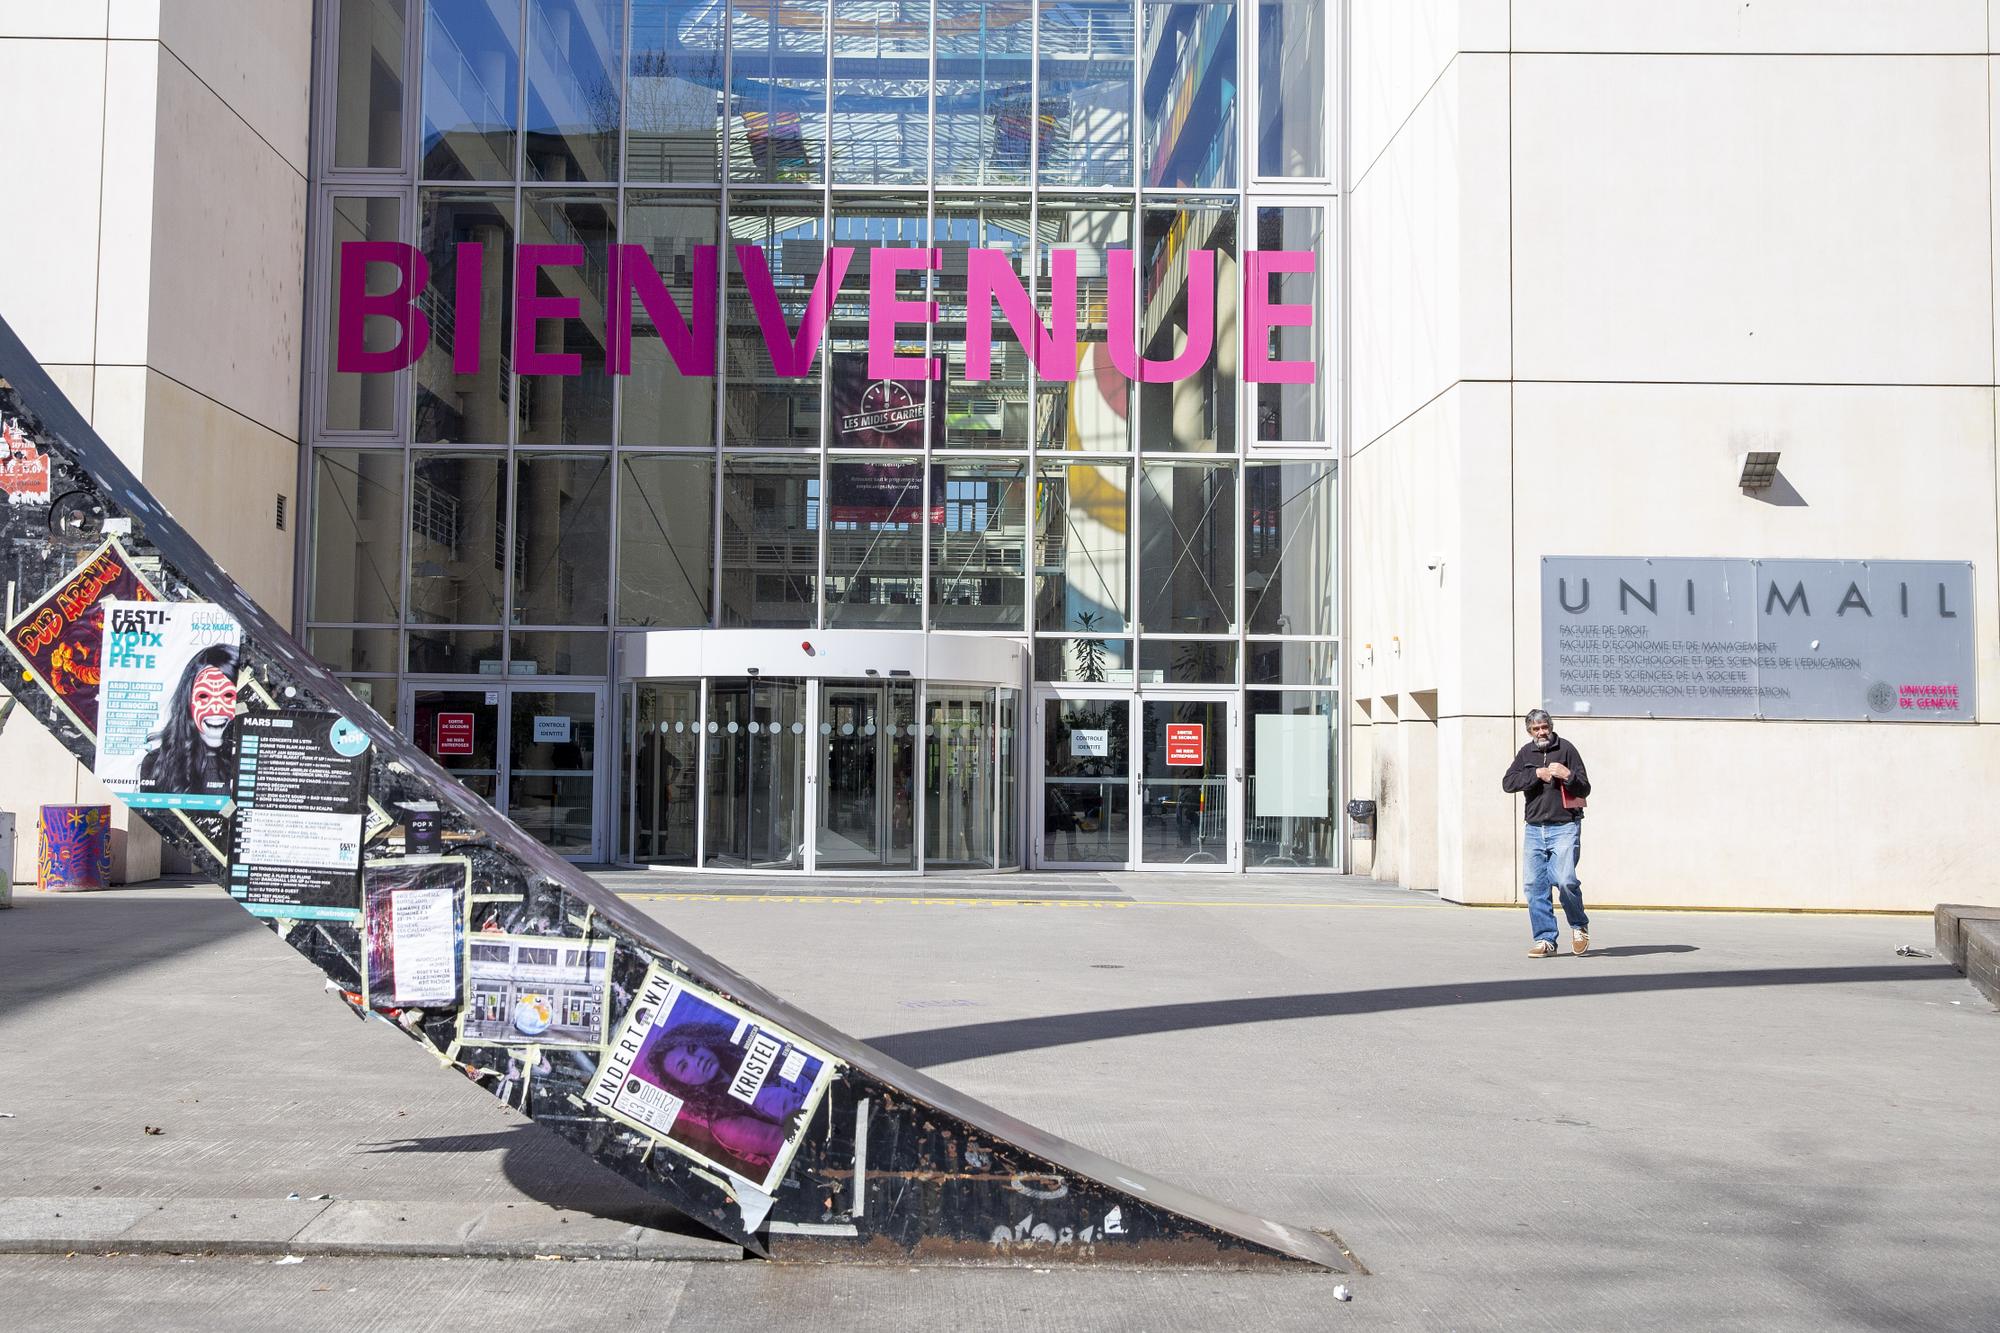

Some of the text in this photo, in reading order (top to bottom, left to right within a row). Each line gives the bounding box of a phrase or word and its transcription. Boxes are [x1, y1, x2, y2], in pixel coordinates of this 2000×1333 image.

[337, 241, 1315, 383] BIENVENUE
[844, 420, 859, 430] LES
[861, 412, 888, 427] MIDIS
[1559, 577, 1957, 617] UNI MAIL
[17, 556, 122, 656] DUB ARENA
[112, 609, 171, 625] FESTI-
[112, 620, 150, 635] VAL
[1560, 625, 1648, 636] FACULTE DE DROIT
[111, 632, 163, 647] VOIX
[190, 630, 234, 646] 2020
[111, 642, 135, 657] DE
[1560, 640, 1599, 650] FACULTE
[1672, 641, 1683, 651] ET
[1686, 641, 1699, 651] DE
[1701, 642, 1777, 653] MANAGEMENT
[1560, 655, 1599, 666] FACULTE
[1602, 655, 1615, 666] DE
[1618, 656, 1688, 666] PSYCHOLOGIE
[1692, 656, 1702, 666] ET
[1705, 656, 1724, 667] DES
[1727, 657, 1778, 668] SCIENCES
[1779, 657, 1792, 668] DE
[1560, 670, 1599, 681] FACULTE
[1602, 670, 1621, 681] DES
[1624, 670, 1673, 681] SCIENCES
[1676, 671, 1690, 681] DE
[1692, 671, 1704, 681] LA
[1560, 684, 1600, 695] FACULTE
[1603, 684, 1616, 695] DE
[1619, 685, 1684, 696] TRADUCTION
[1686, 685, 1698, 696] ET
[1899, 698, 1913, 708] DE
[243, 718, 271, 727] MARS
[734, 1034, 776, 1099] KRISTEL
